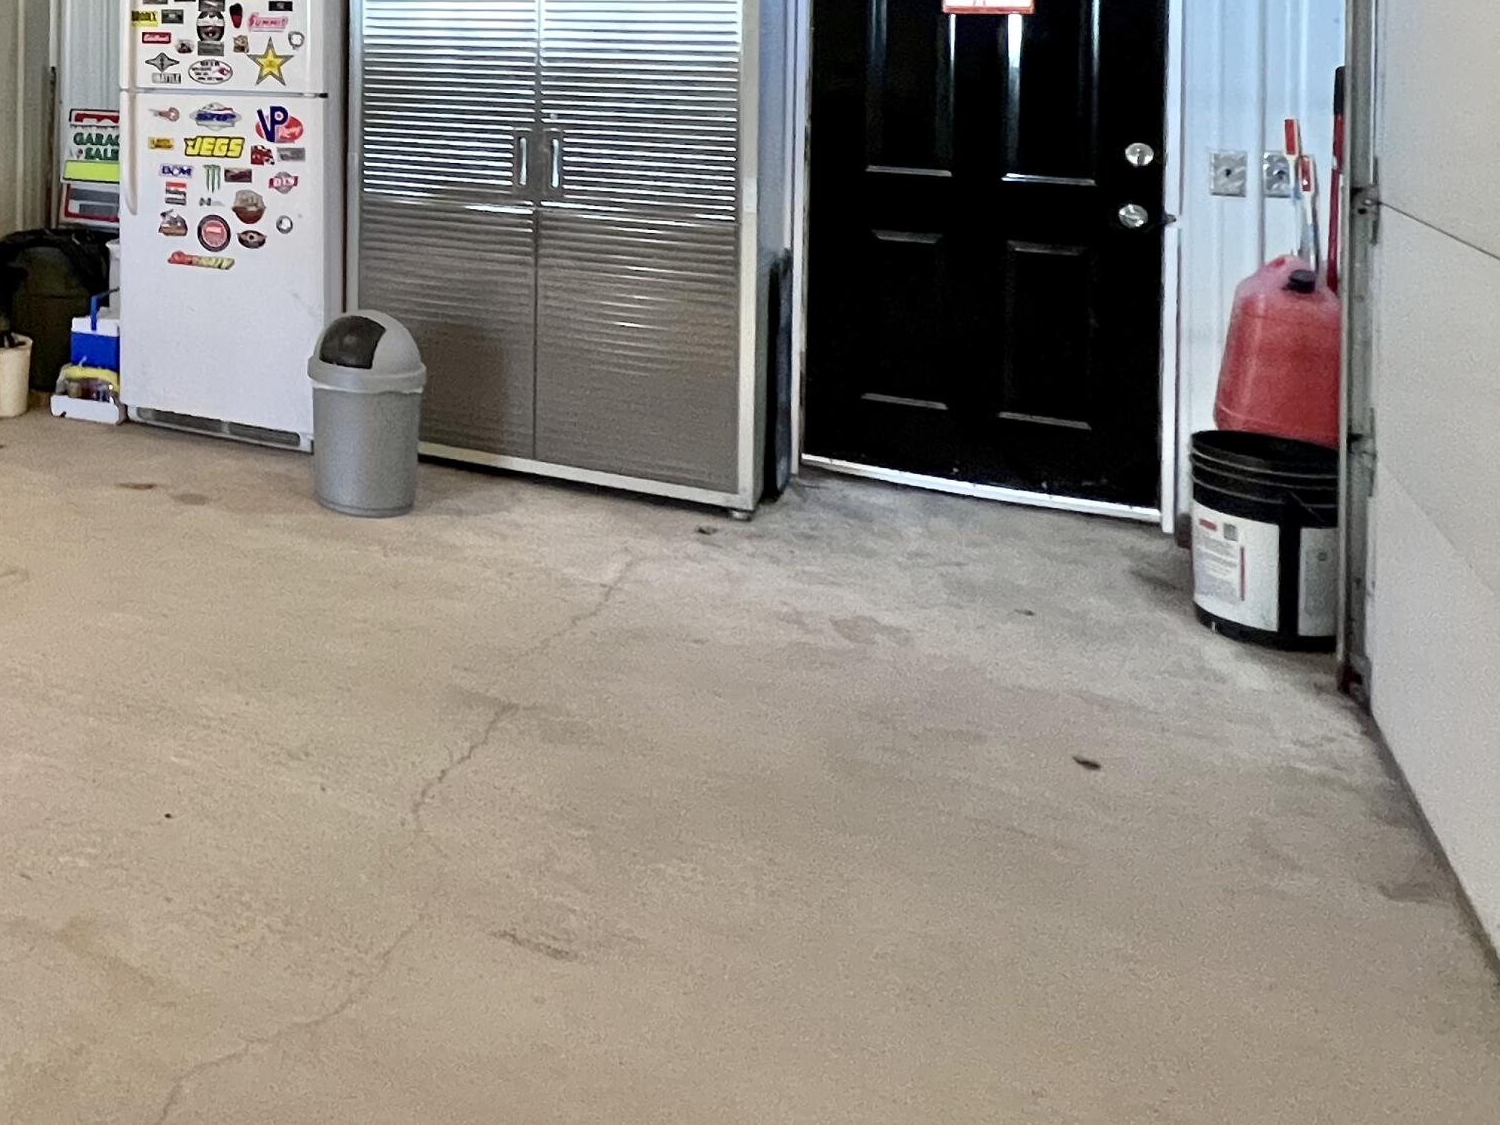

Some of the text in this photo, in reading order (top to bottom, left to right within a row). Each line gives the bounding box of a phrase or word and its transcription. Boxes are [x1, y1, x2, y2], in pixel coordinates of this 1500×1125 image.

[257, 106, 289, 143] VP
[73, 131, 120, 147] GARA
[184, 135, 245, 158] JEGS
